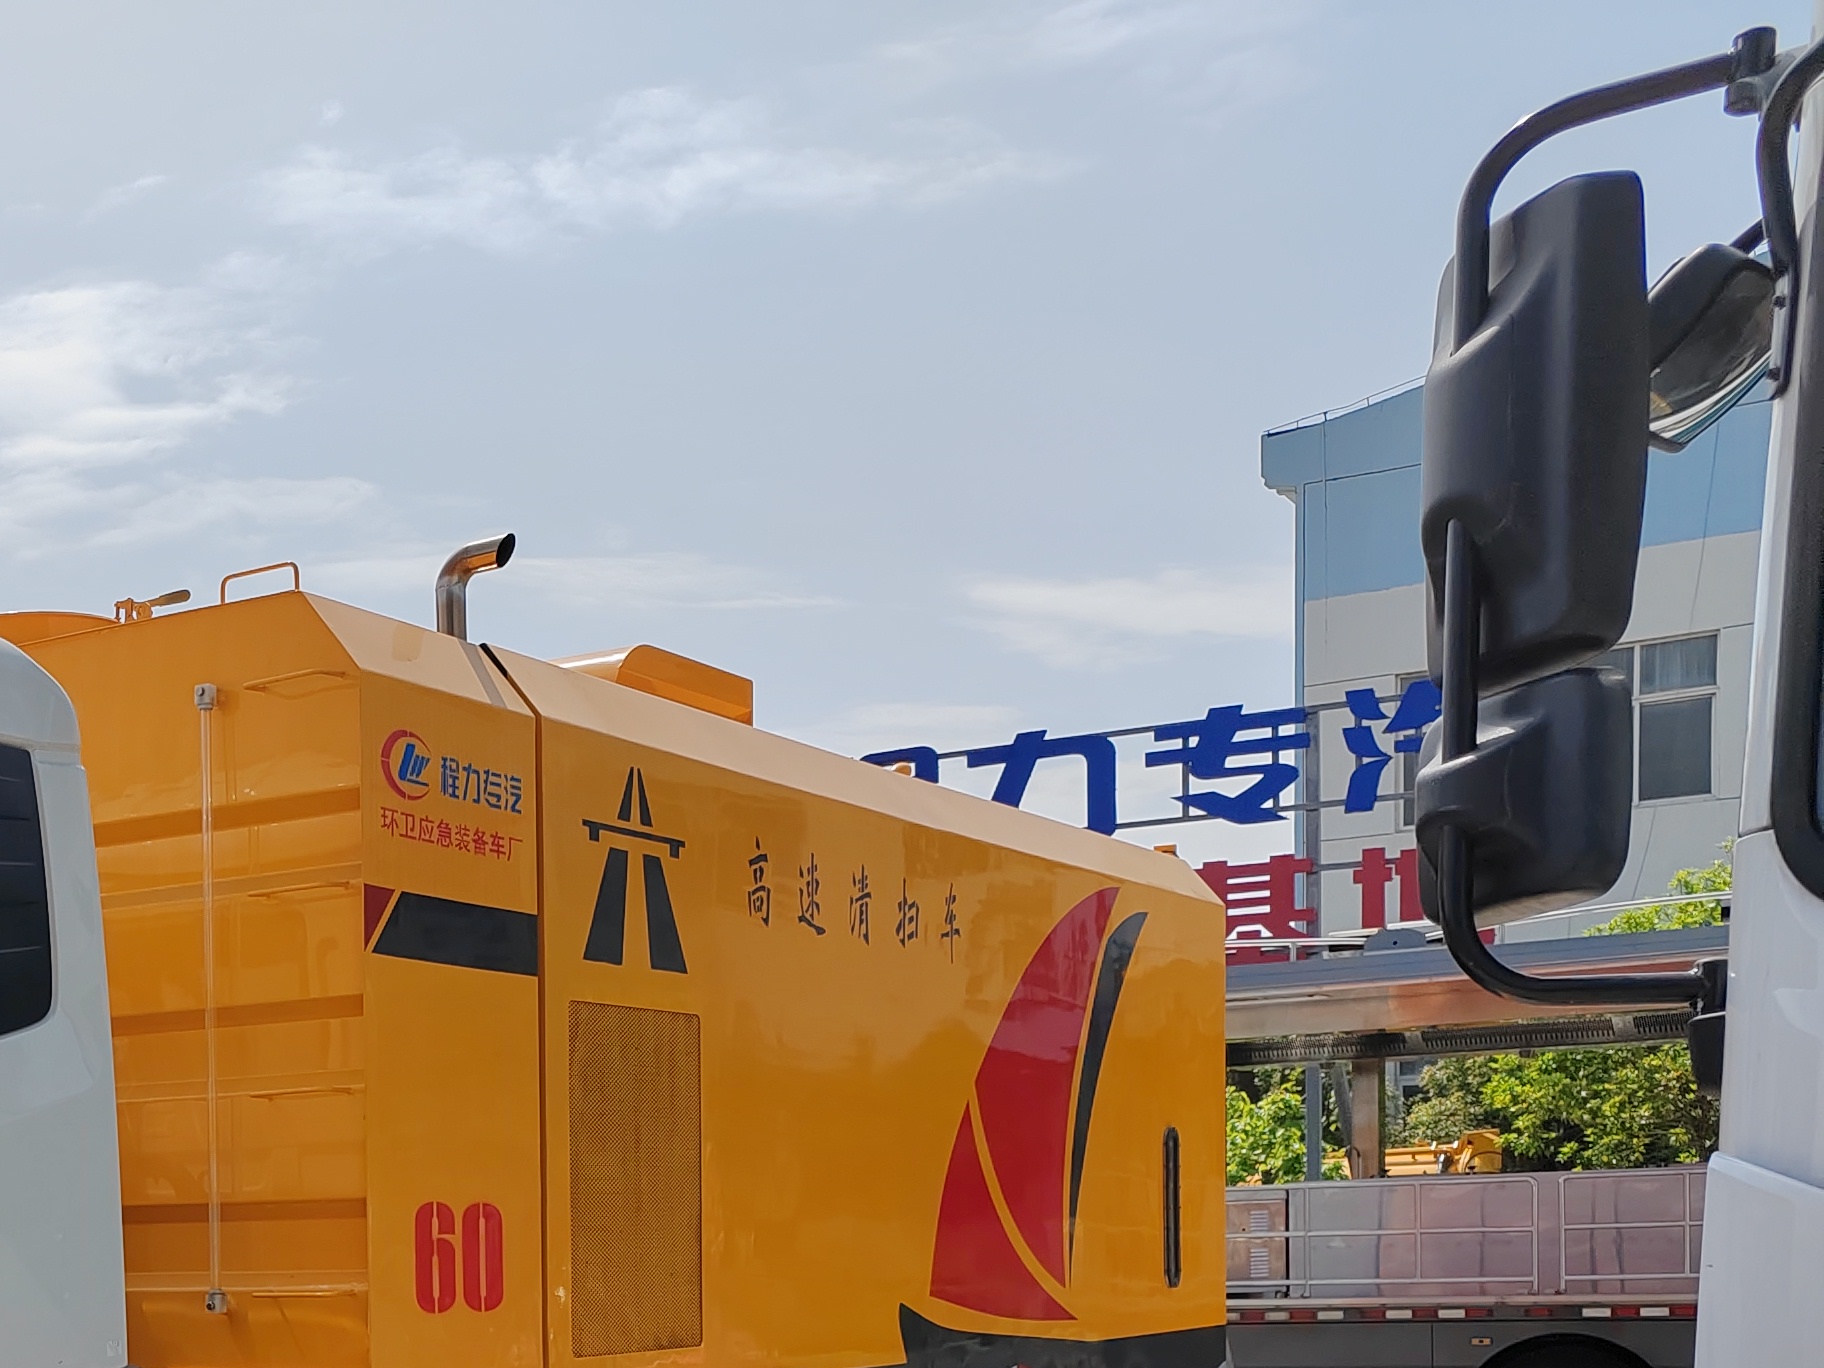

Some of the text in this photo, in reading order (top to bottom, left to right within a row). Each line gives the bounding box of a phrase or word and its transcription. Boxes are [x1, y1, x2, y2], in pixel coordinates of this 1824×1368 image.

[440, 756, 523, 815] 程力专汽
[380, 806, 524, 862] 环卫应急装备车厂
[747, 834, 962, 965] 高速清扫车
[415, 1201, 504, 1313] 60
